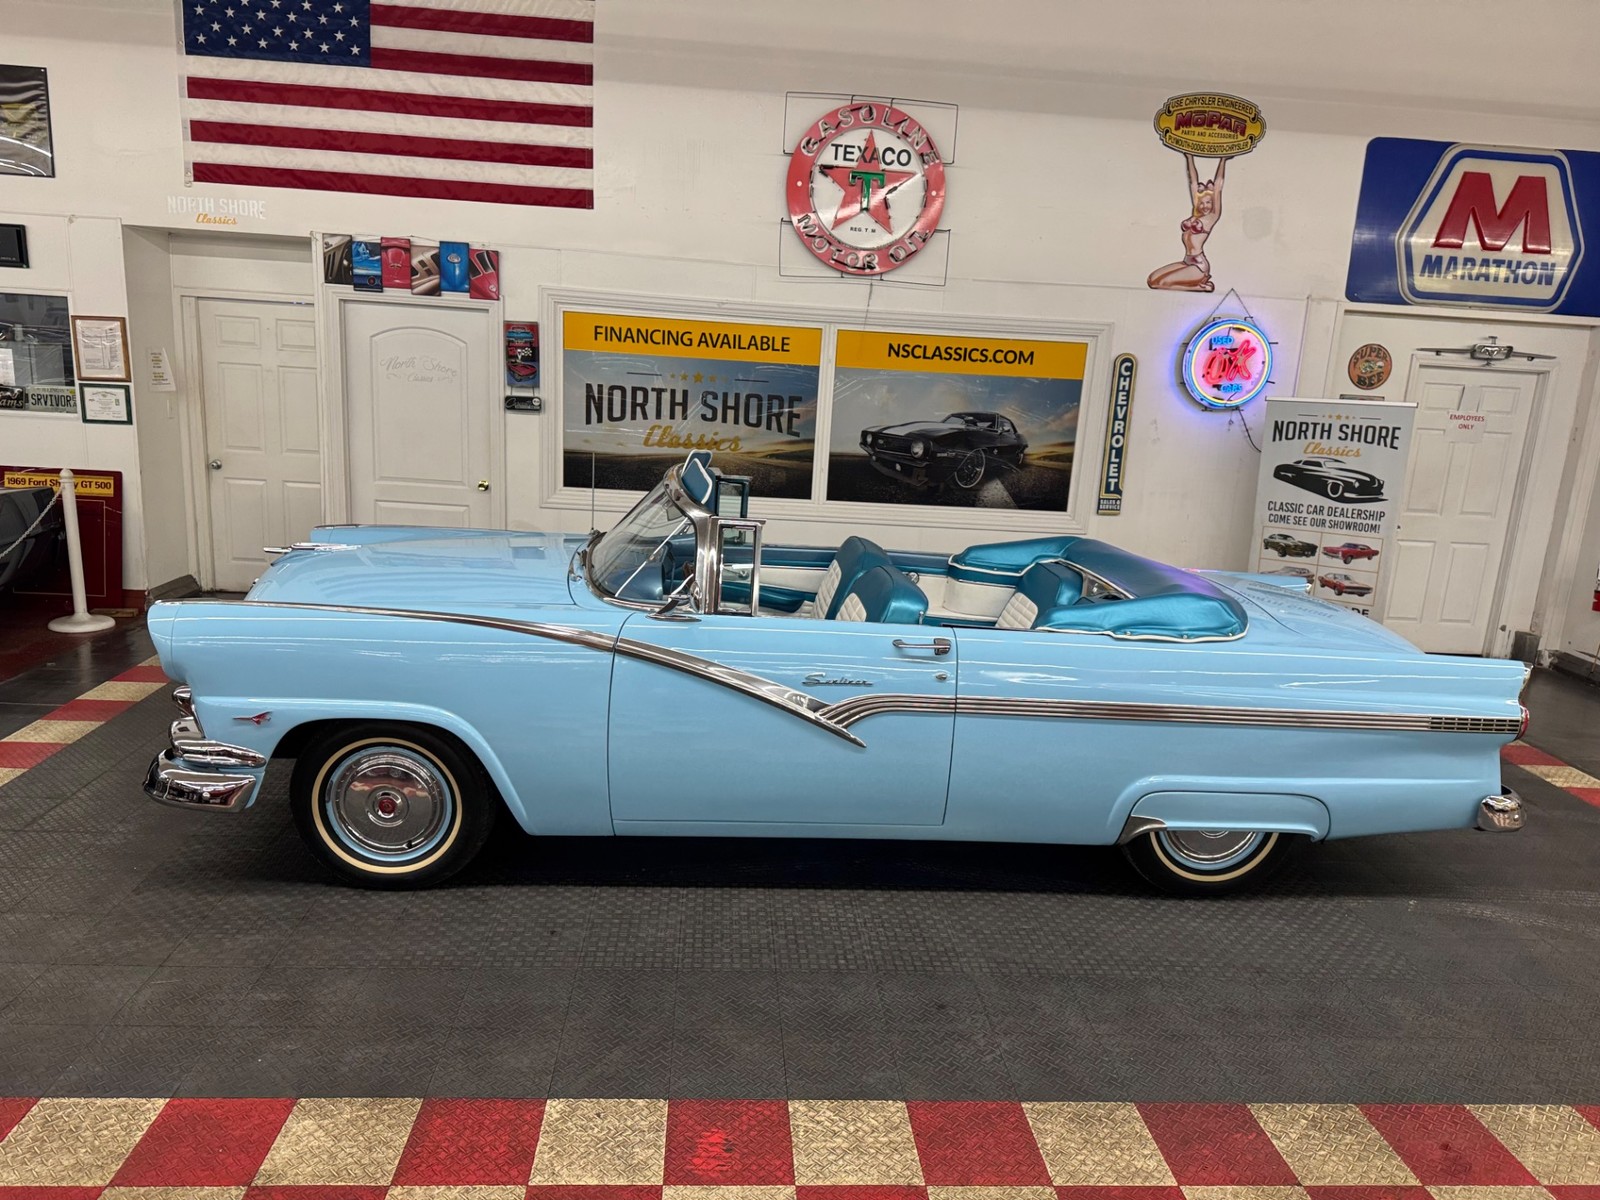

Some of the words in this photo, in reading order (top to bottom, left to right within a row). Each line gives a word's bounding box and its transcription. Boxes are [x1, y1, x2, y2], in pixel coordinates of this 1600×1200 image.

[1171, 99, 1183, 109] USE
[1185, 96, 1216, 107] CHRYSLER
[1217, 97, 1253, 115] ENGINEERED
[1174, 110, 1247, 137] MOPAR
[801, 103, 940, 169] GASOLINE
[1208, 132, 1238, 140] ACCESSORIES
[831, 143, 912, 167] TEXACO
[849, 171, 886, 211] T
[167, 195, 214, 214] NORTH
[219, 198, 266, 220] SHORE
[196, 213, 238, 225] Classics
[1431, 171, 1552, 254] M
[797, 213, 879, 272] MOTOR
[889, 229, 931, 263] OIL
[1419, 254, 1556, 286] MARATHON
[594, 325, 693, 347] FINANCING
[697, 332, 790, 352] AVAILABLE
[888, 342, 1034, 366] NSCLASSICS.COM
[1204, 339, 1257, 385] OK
[1353, 346, 1388, 369] SUPER
[1357, 371, 1385, 388] BEE
[31, 393, 72, 408] SRVIVOR
[585, 382, 689, 426] NORTH
[701, 390, 803, 438] SHORE
[1108, 362, 1132, 492] CHEVROLET
[1450, 413, 1485, 422] EMPLOYEES
[643, 424, 743, 452] Classics
[1272, 420, 1332, 442] NORTH
[1338, 423, 1401, 450] SHORE
[1303, 442, 1361, 458] Classics
[6, 476, 26, 486] 1969
[28, 478, 48, 487] Ford
[81, 481, 93, 489] GT
[94, 481, 112, 490] 500
[1267, 501, 1304, 514] CLASSIC
[1306, 505, 1324, 516] CAR
[1327, 507, 1386, 522] DEALERSHIP
[1268, 513, 1291, 524] COME
[1293, 516, 1307, 526] SEE
[1309, 517, 1326, 528] OUR
[1328, 519, 1381, 534] SHOWROOM!
